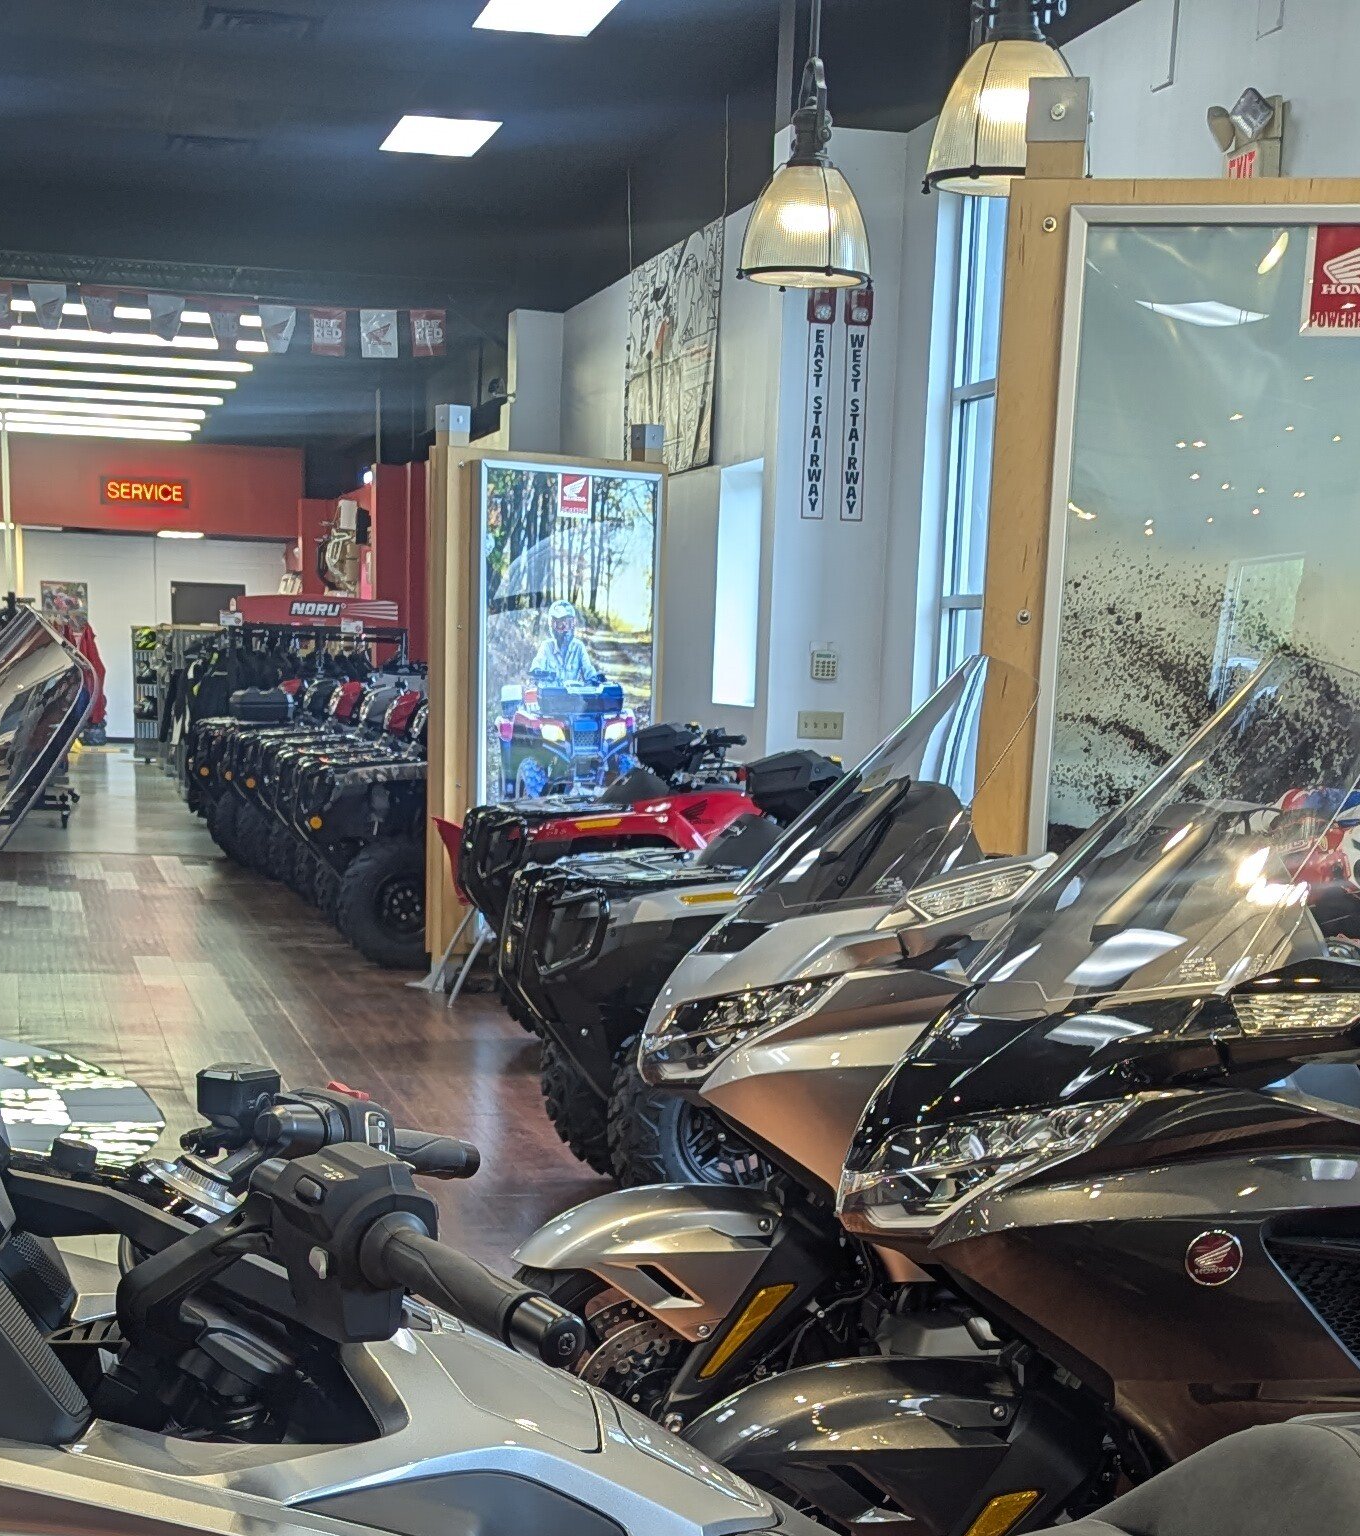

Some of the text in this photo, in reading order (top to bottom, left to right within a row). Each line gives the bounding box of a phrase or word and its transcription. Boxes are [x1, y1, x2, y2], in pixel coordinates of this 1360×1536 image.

[314, 328, 343, 340] RED
[807, 329, 825, 511] EAST STAIRWAY
[845, 334, 865, 514] WEST STAIRWAY
[107, 481, 183, 502] SERVICE
